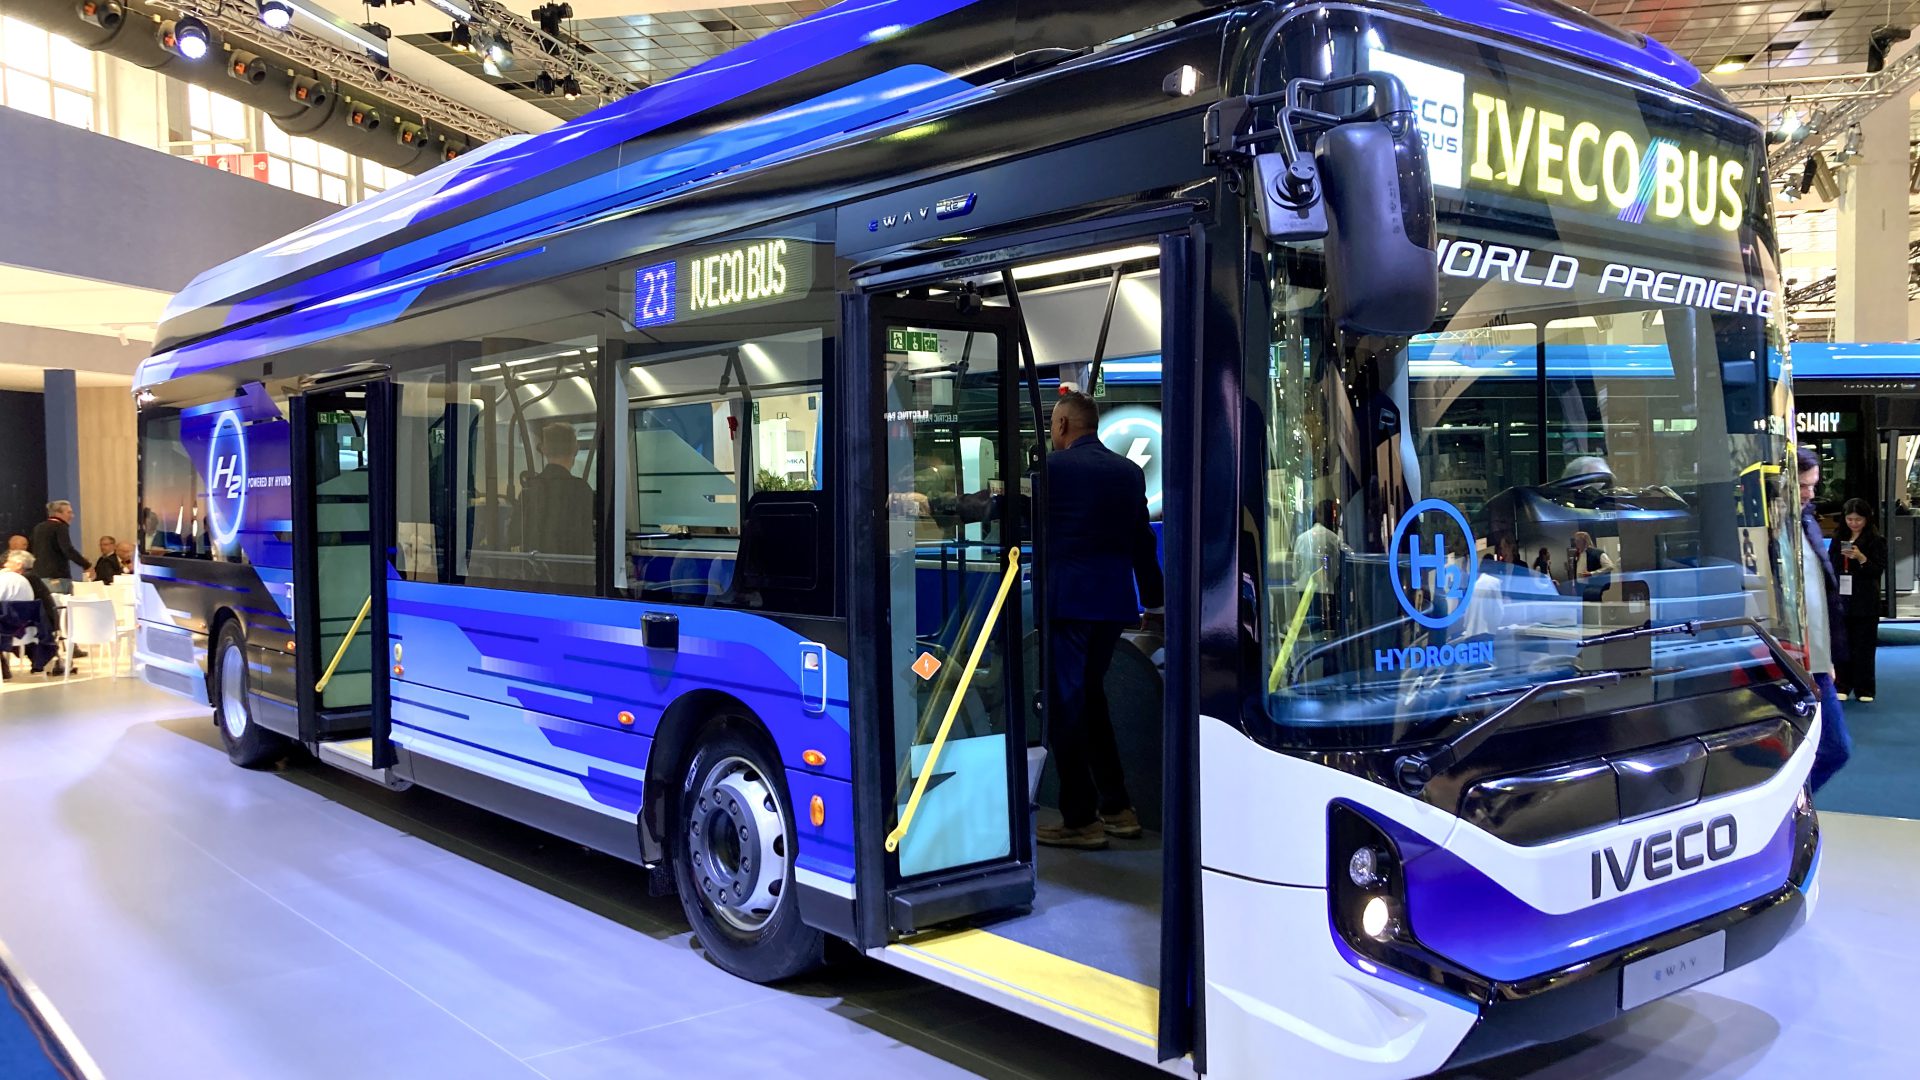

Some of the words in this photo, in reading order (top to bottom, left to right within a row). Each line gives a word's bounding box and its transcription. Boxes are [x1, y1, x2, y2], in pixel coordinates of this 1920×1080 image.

[1470, 92, 1640, 209] IVECO
[1655, 141, 1744, 231] BUS
[643, 269, 668, 319] 23
[690, 249, 744, 311] IVECO
[746, 239, 787, 300] BUS
[1597, 263, 1777, 318] PREMIERE
[212, 454, 242, 498] H2
[248, 477, 267, 488] POWERED
[268, 477, 275, 487] BY
[1409, 534, 1464, 598] H2
[1375, 640, 1495, 672] HYDROGEN
[1591, 813, 1738, 900] IVECO
